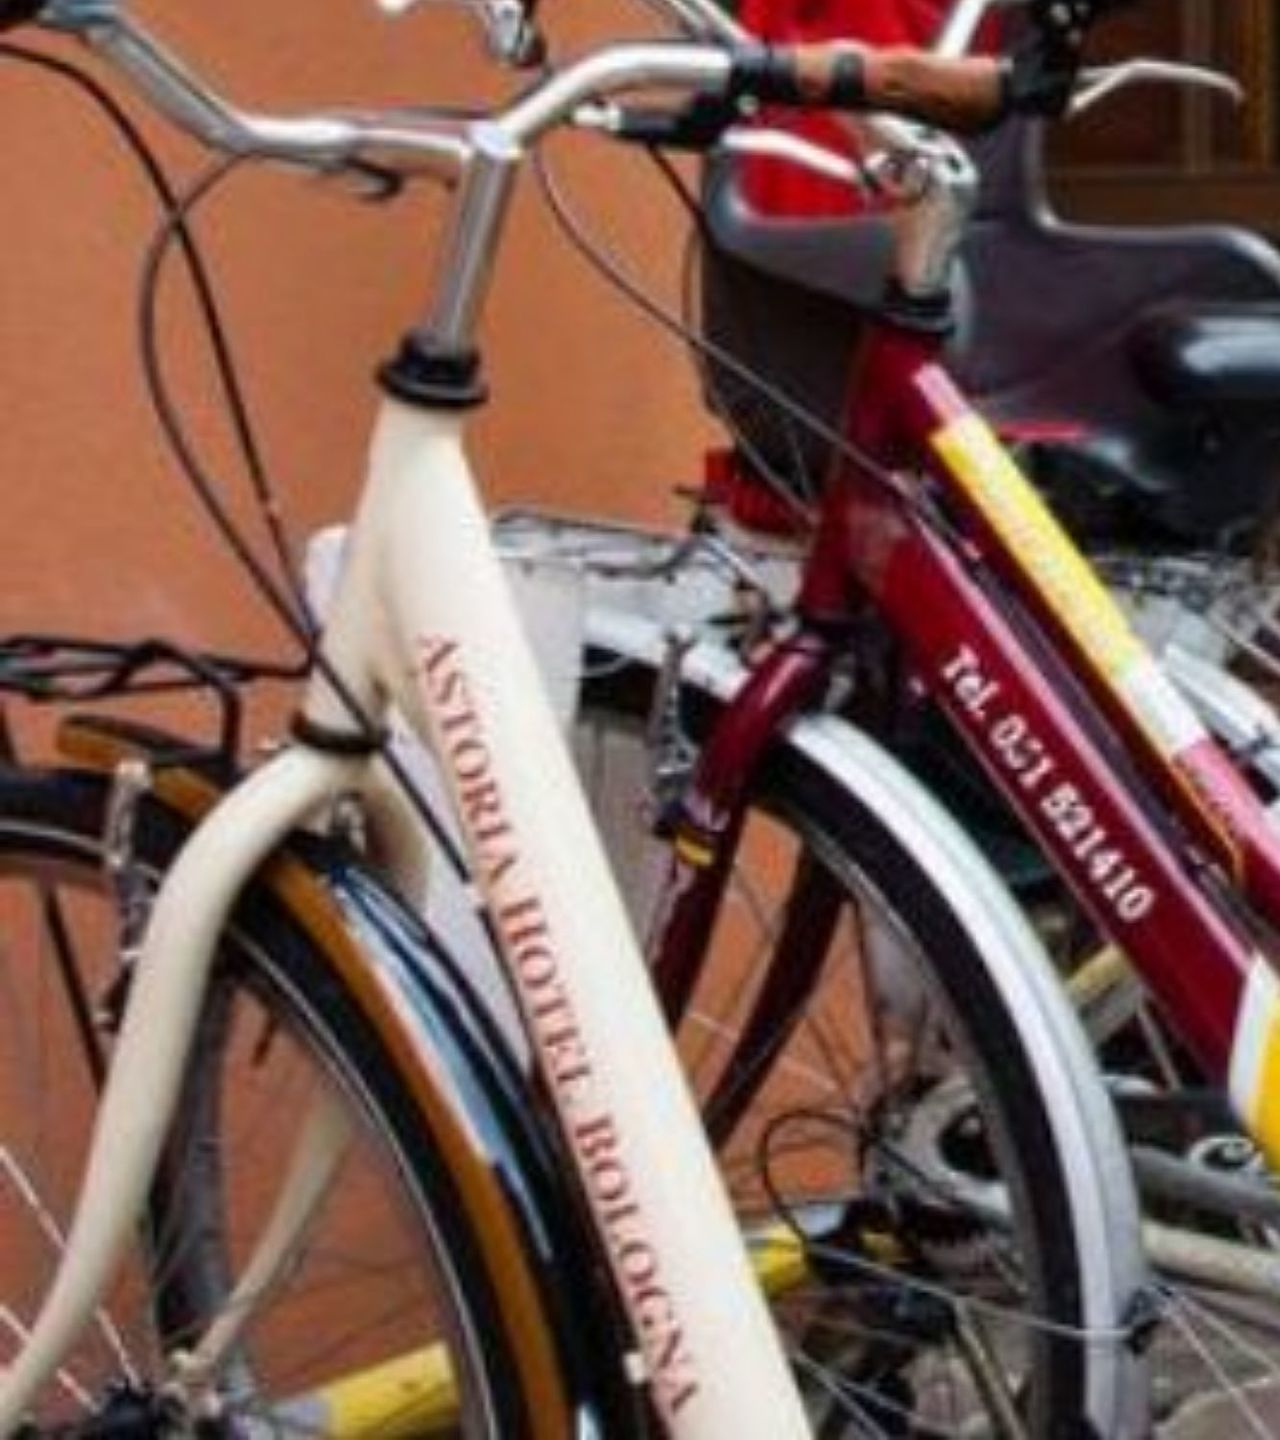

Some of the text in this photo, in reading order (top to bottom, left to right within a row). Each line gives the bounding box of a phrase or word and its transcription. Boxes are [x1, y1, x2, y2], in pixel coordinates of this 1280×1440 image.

[991, 714, 1053, 789] 051
[417, 633, 700, 1417] ASTORIA HOTEL BOLOGNA
